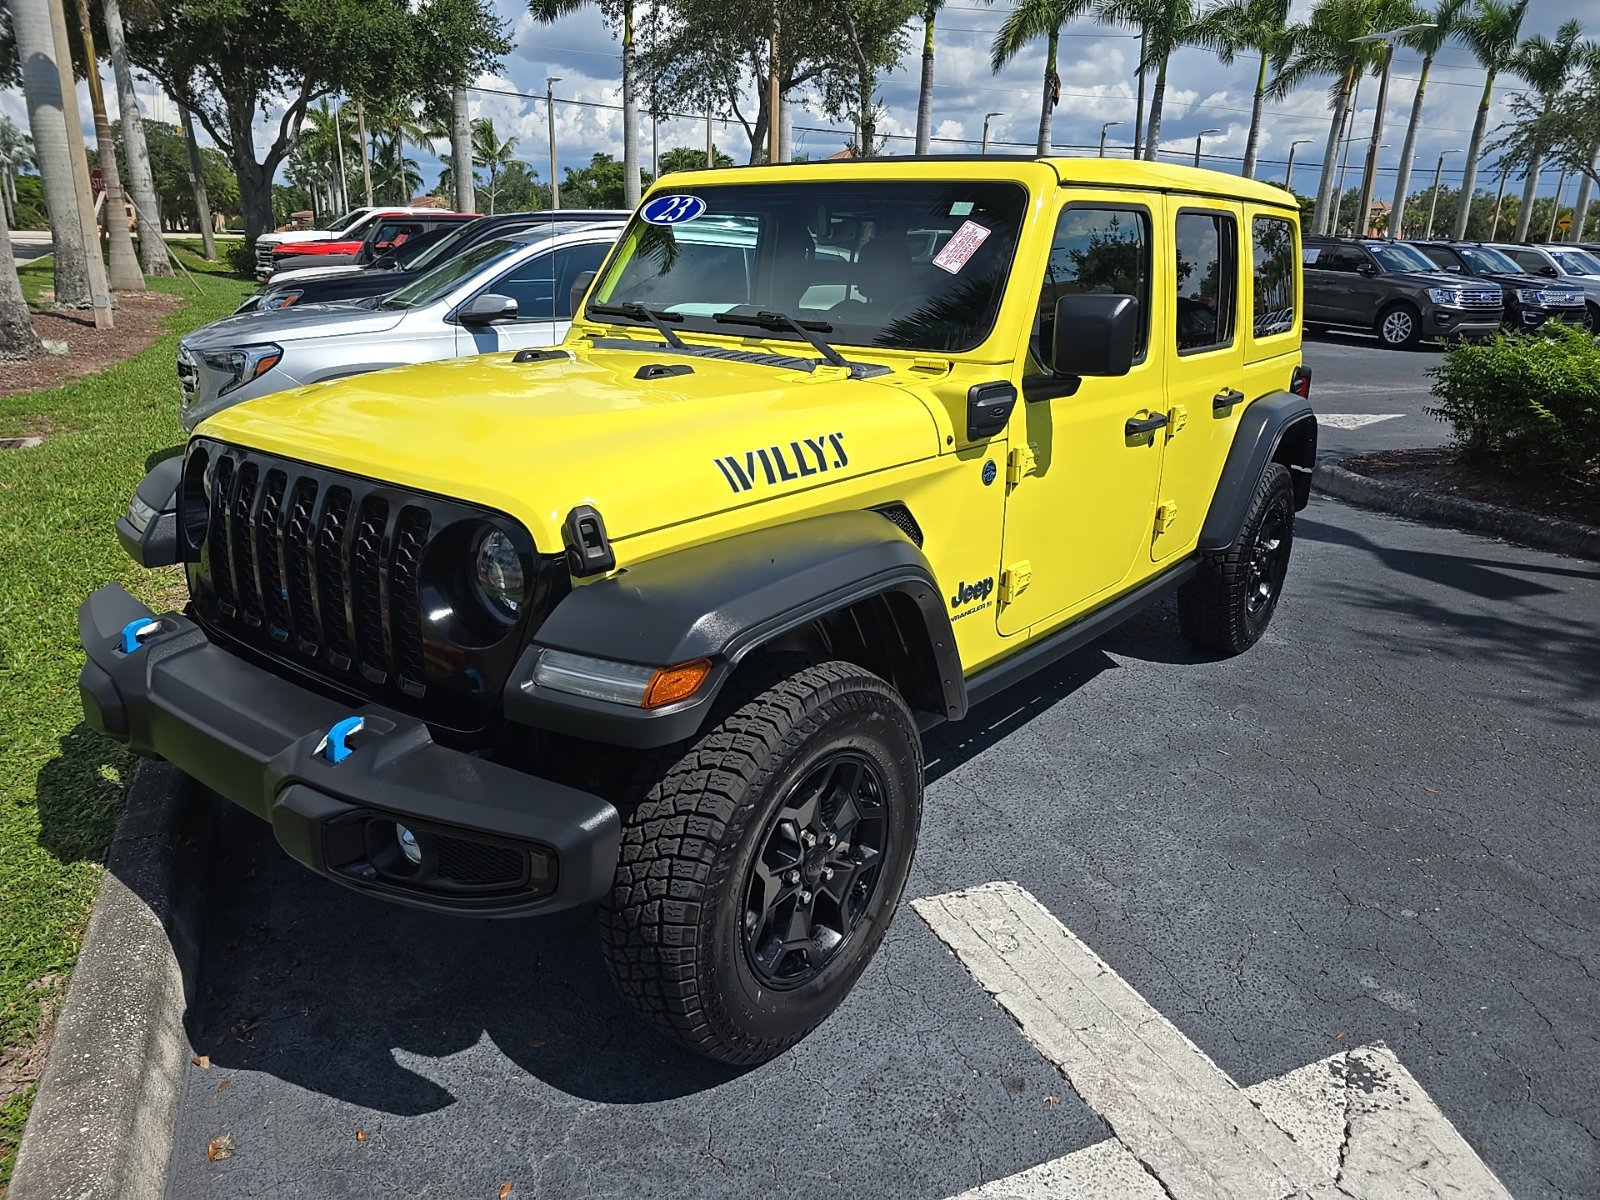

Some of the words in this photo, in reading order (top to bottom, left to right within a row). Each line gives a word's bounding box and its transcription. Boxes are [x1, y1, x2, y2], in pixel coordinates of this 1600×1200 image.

[653, 197, 694, 222] 23
[713, 432, 848, 493] WILLYS
[951, 576, 994, 609] Jeep
